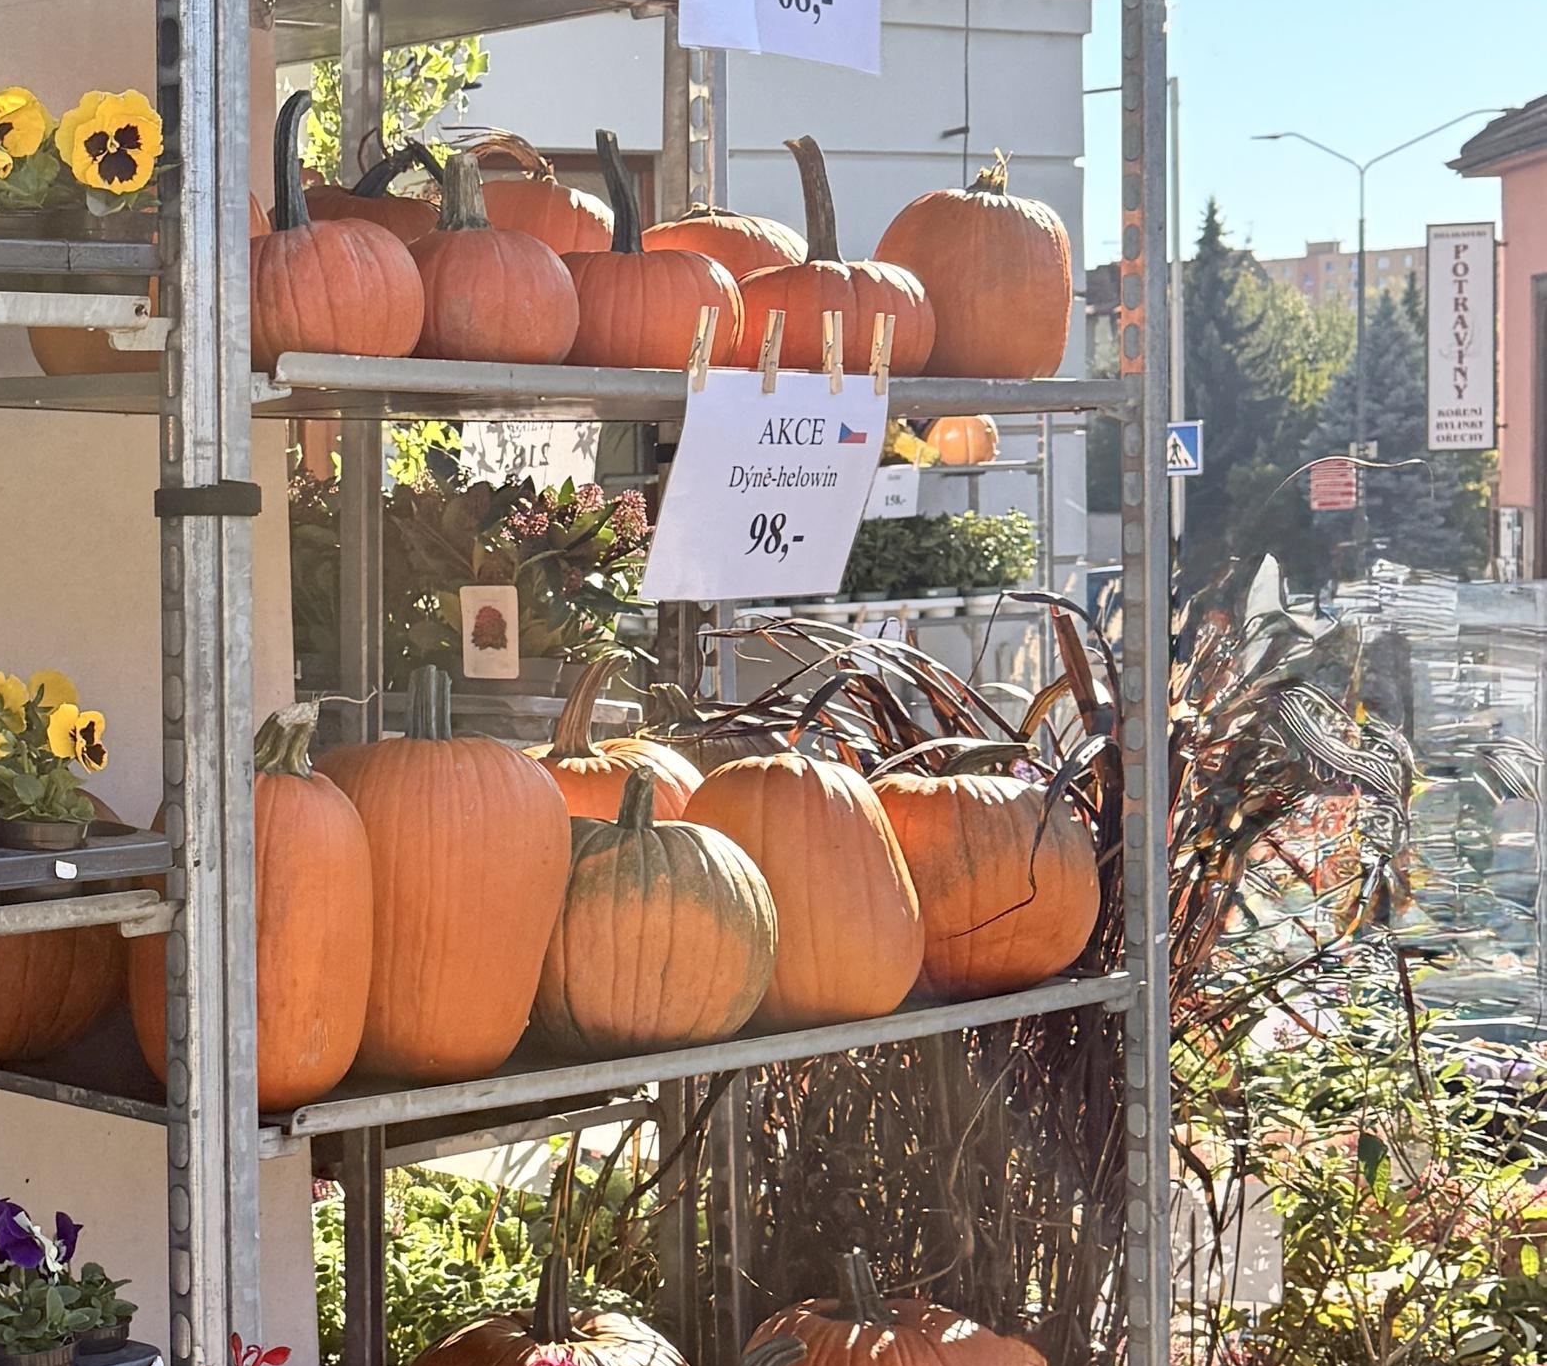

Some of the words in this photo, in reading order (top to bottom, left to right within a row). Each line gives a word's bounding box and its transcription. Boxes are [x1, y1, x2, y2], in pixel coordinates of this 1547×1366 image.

[1452, 244, 1469, 400] POTRAVINY
[758, 418, 826, 446] AKCE
[729, 465, 838, 493] Dýně-helowin
[744, 513, 804, 562] 98,-
